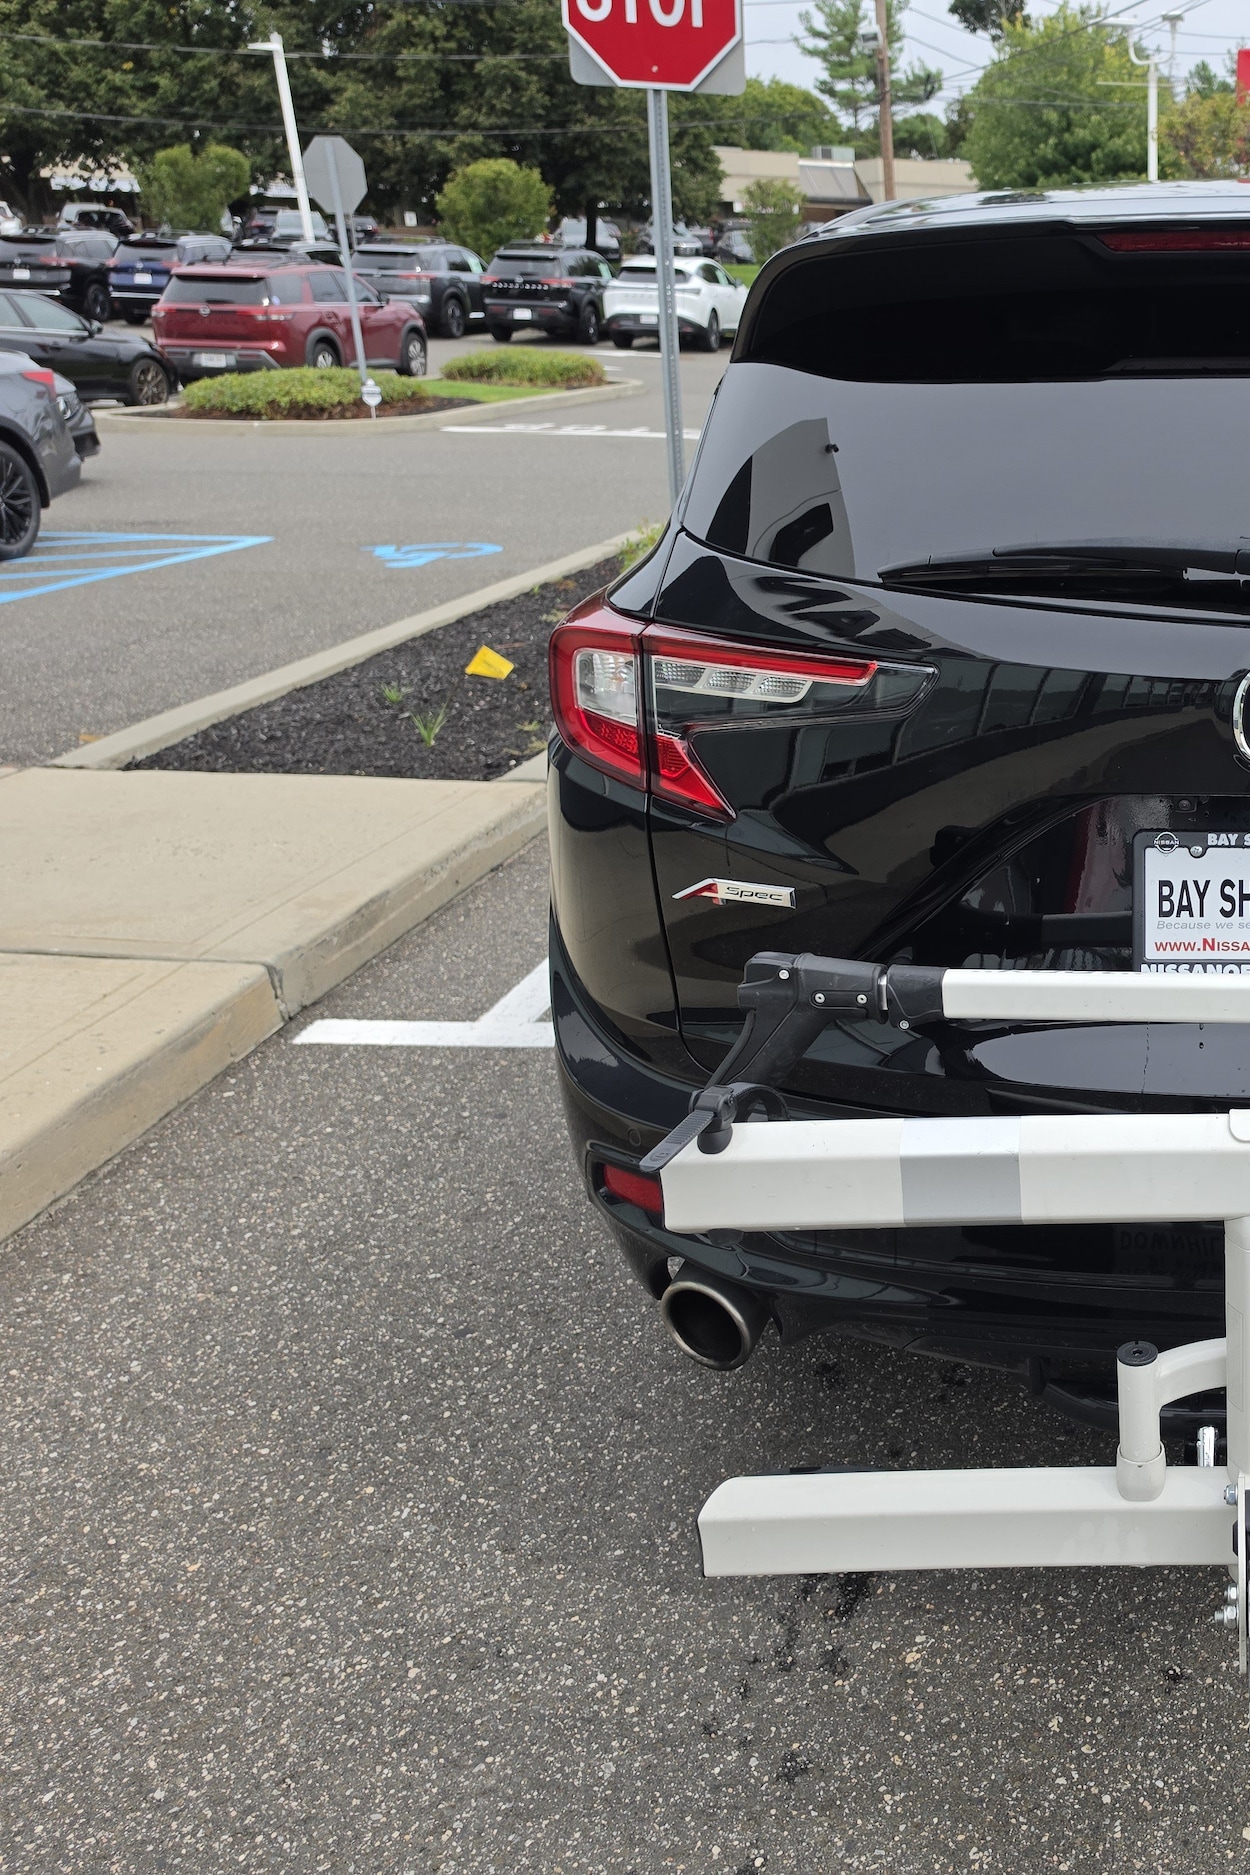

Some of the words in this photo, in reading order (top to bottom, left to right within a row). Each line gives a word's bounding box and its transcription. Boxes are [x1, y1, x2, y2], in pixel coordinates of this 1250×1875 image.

[1207, 833, 1238, 846] BAY
[1159, 879, 1211, 917] BAY
[1156, 920, 1211, 930] Because
[1215, 922, 1233, 930] we
